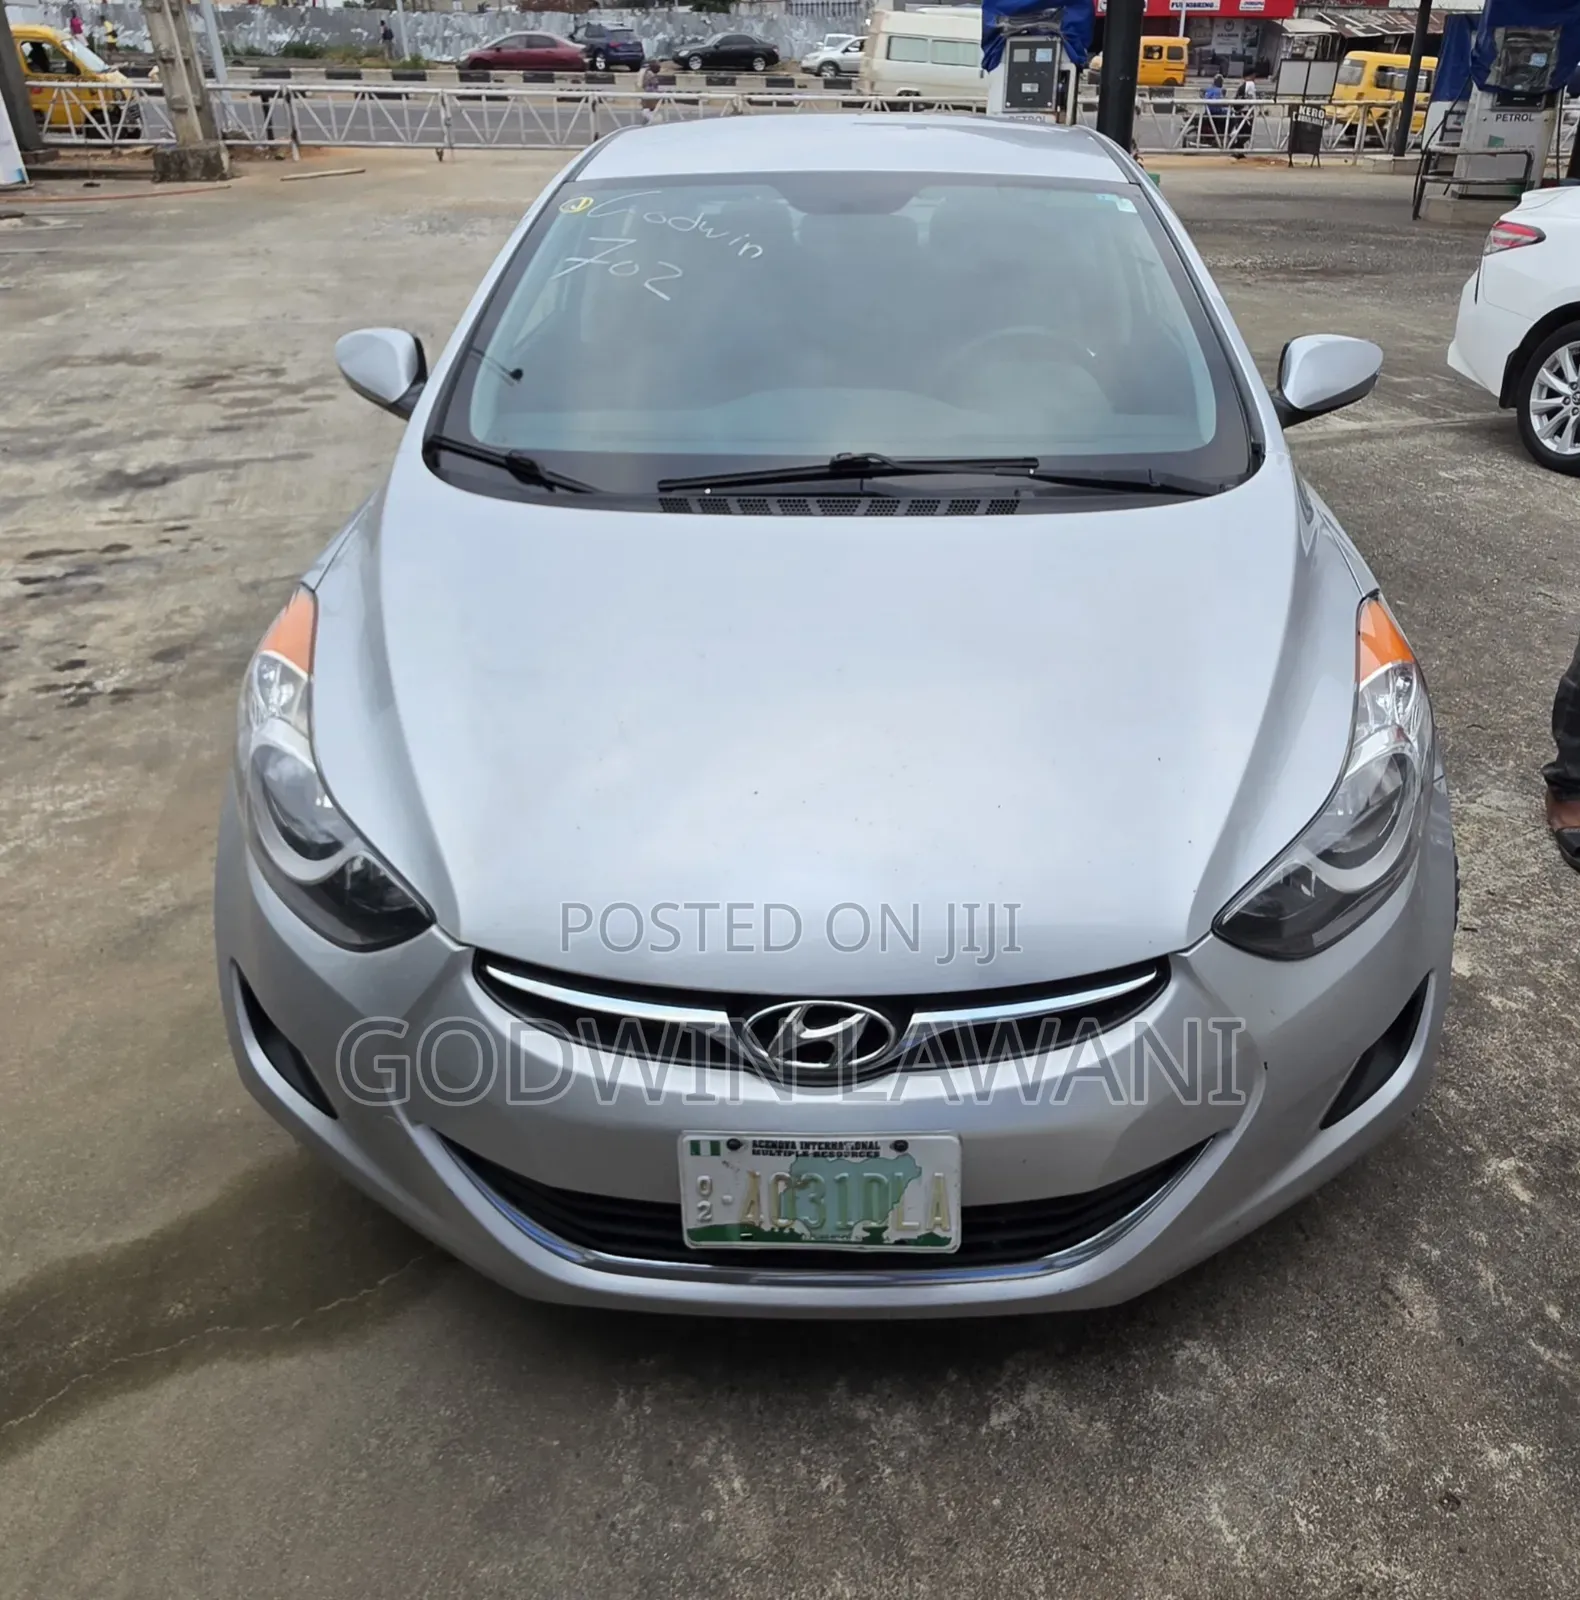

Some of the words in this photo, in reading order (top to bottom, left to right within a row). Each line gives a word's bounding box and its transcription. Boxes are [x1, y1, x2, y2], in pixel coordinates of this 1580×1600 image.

[1299, 105, 1325, 118] KERO
[1495, 113, 1534, 122] PETROL
[587, 190, 763, 259] Godwin
[551, 235, 683, 301] 702
